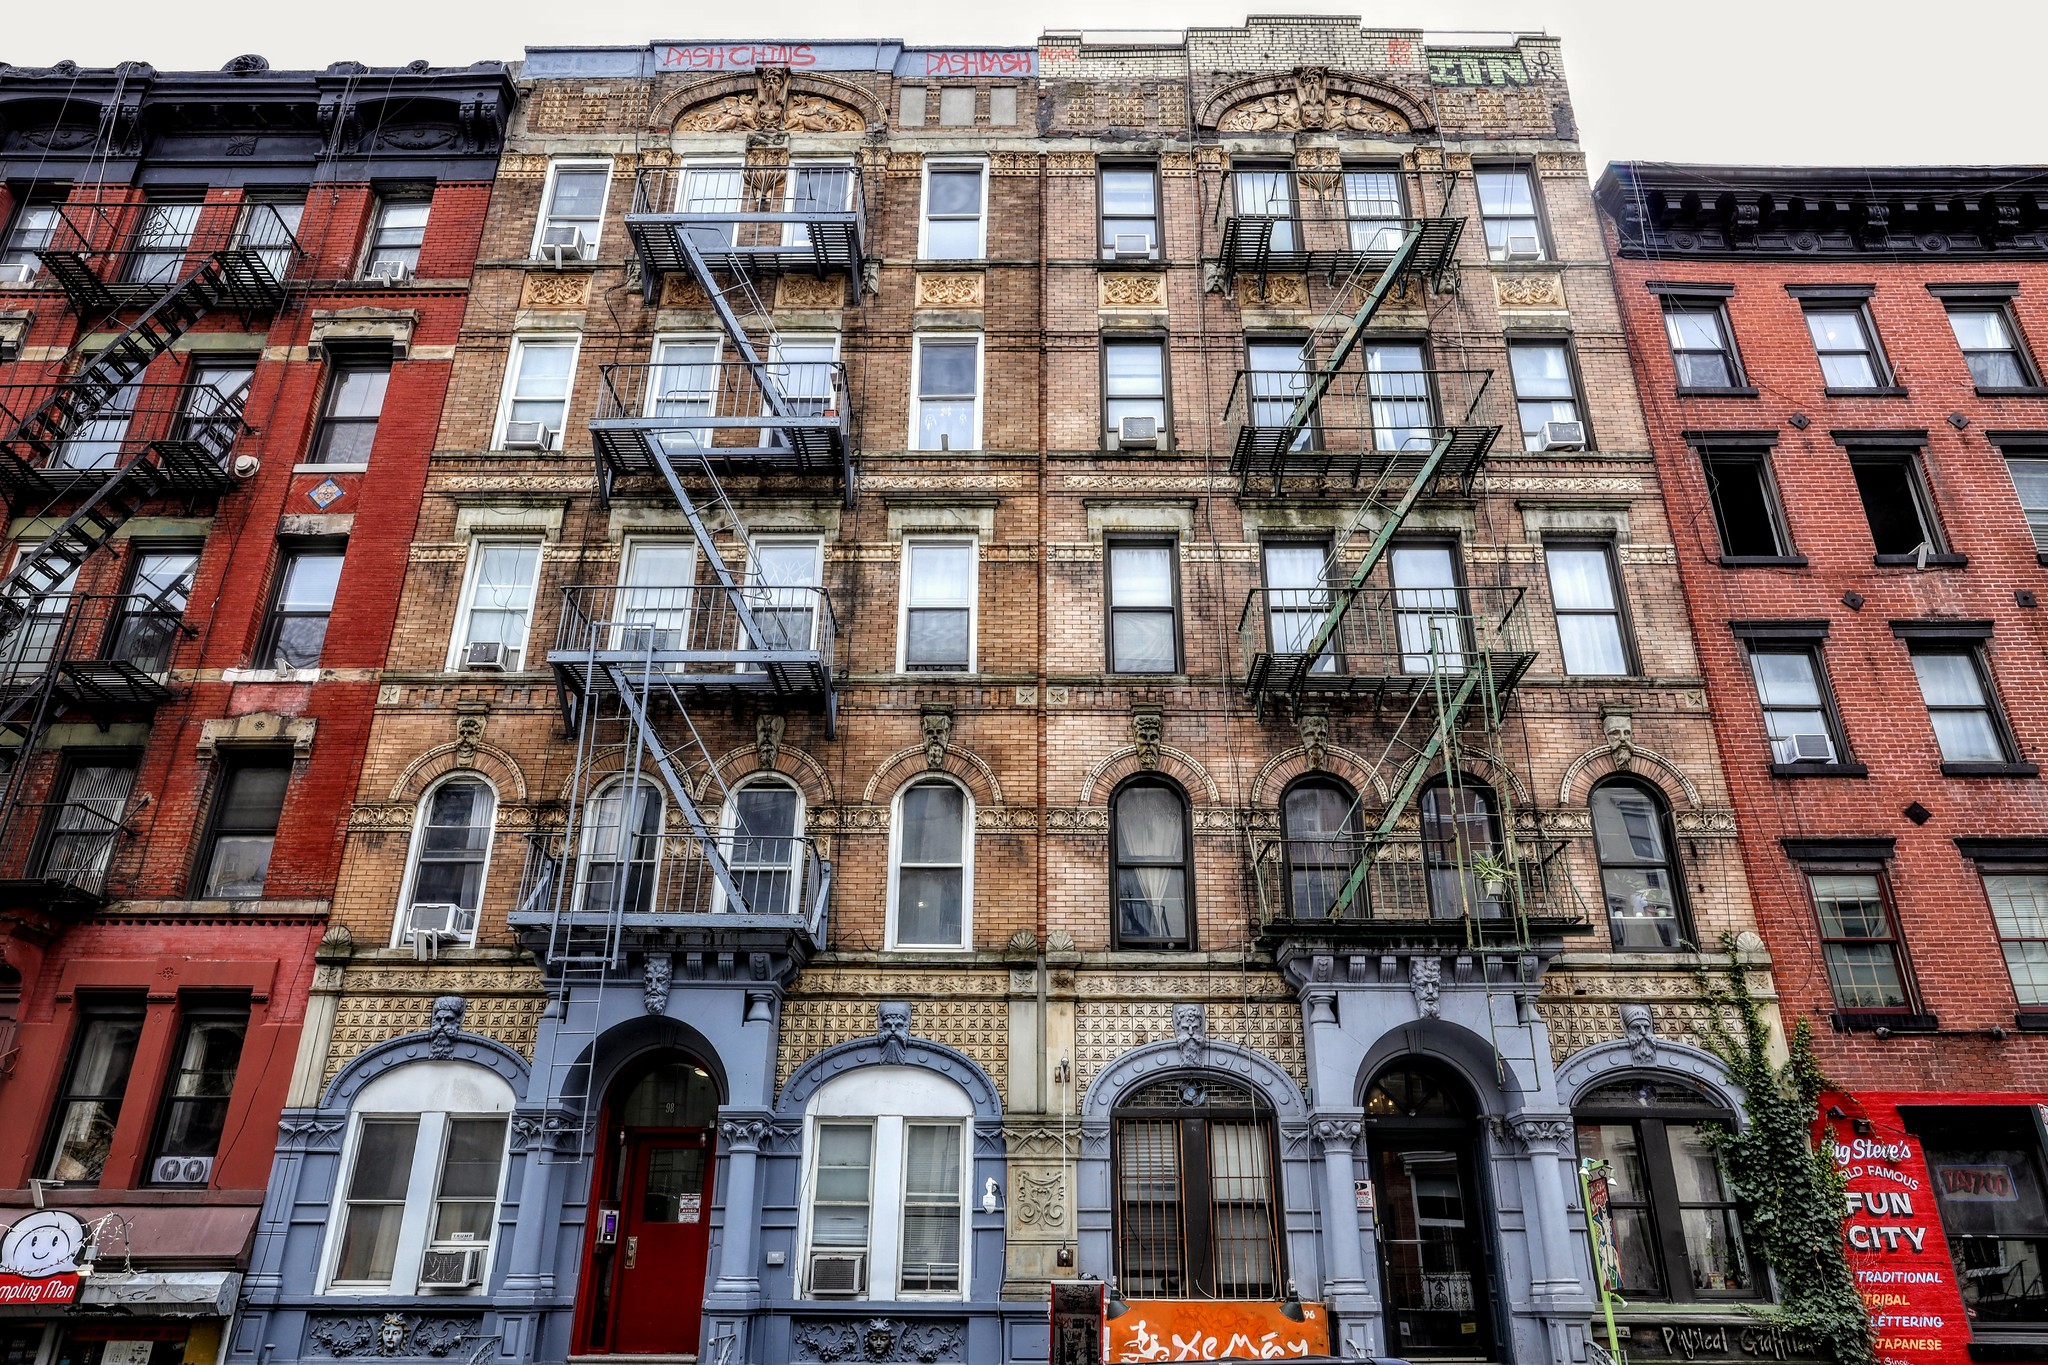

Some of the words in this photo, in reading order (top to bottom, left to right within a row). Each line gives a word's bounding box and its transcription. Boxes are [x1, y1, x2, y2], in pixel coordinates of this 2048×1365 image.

[665, 1102, 675, 1114] 98
[1852, 1138, 1912, 1160] Steve's
[1867, 1165, 1919, 1191] FAMOUS
[1844, 1192, 1914, 1217] FUN
[1847, 1224, 1927, 1252] CITY
[1857, 1271, 1943, 1284] TRADITIONAL
[42, 1280, 75, 1299] Man
[1863, 1293, 1911, 1306] TRIBAL
[1303, 1310, 1316, 1320] 96
[1869, 1315, 1945, 1328] LETTERING
[1874, 1338, 1943, 1351] JAPANESE
